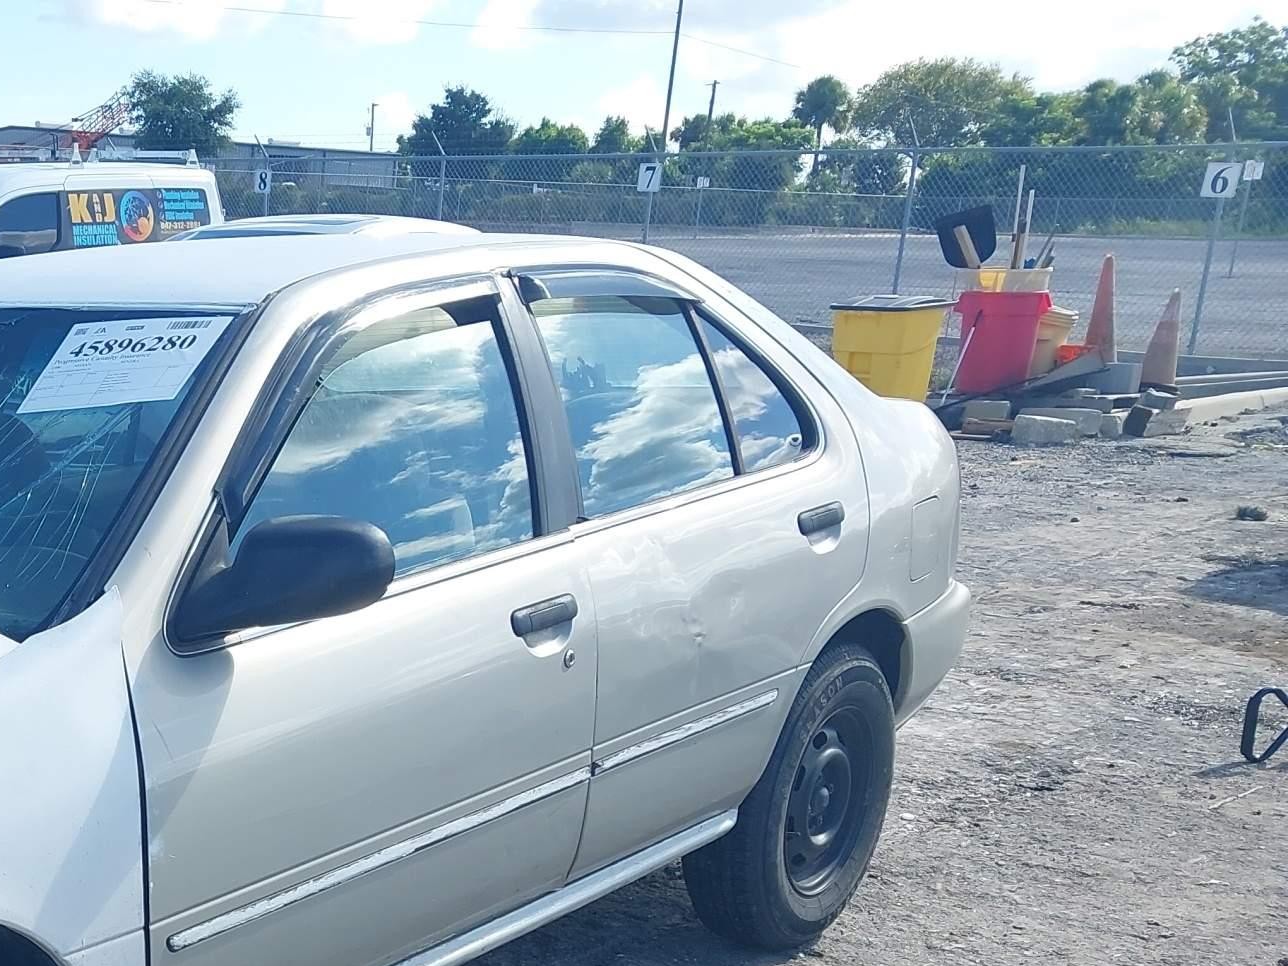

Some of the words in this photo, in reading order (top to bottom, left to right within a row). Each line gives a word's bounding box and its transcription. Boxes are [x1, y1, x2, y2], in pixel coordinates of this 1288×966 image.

[258, 171, 268, 191] 8
[644, 166, 657, 188] 7
[1210, 166, 1233, 194] 6
[68, 193, 93, 223] K
[103, 193, 116, 222] J
[72, 223, 117, 236] MECHANICAL
[73, 234, 118, 246] INSULATION
[69, 333, 198, 358] 45896280
